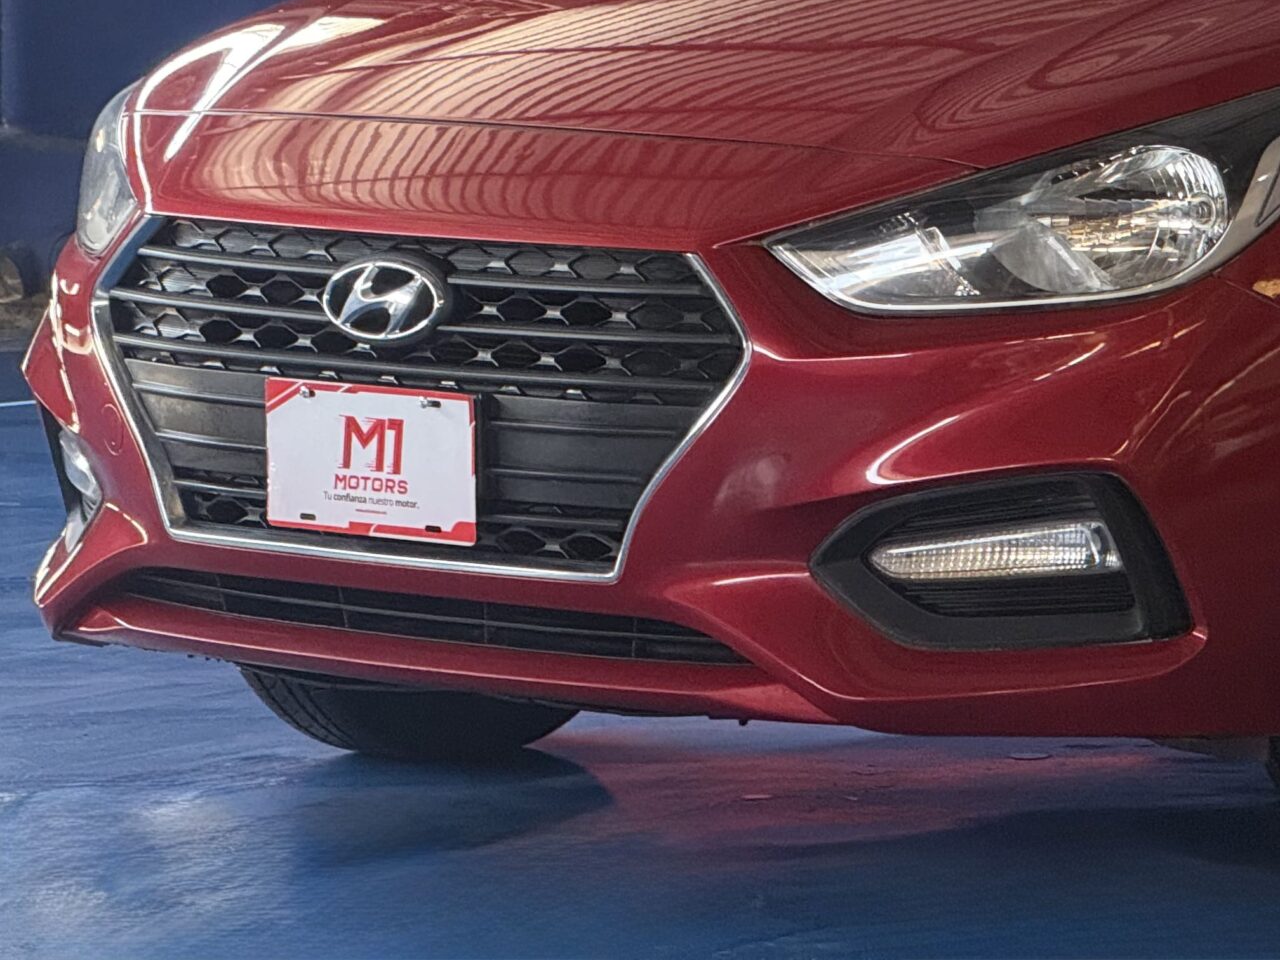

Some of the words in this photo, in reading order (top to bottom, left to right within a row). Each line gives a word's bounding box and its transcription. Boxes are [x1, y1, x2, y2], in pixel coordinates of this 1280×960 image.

[338, 414, 404, 474] M1
[333, 473, 408, 494] MOTORS
[323, 491, 333, 501] Tu
[333, 493, 367, 504] confianza
[368, 496, 394, 507] nuestro
